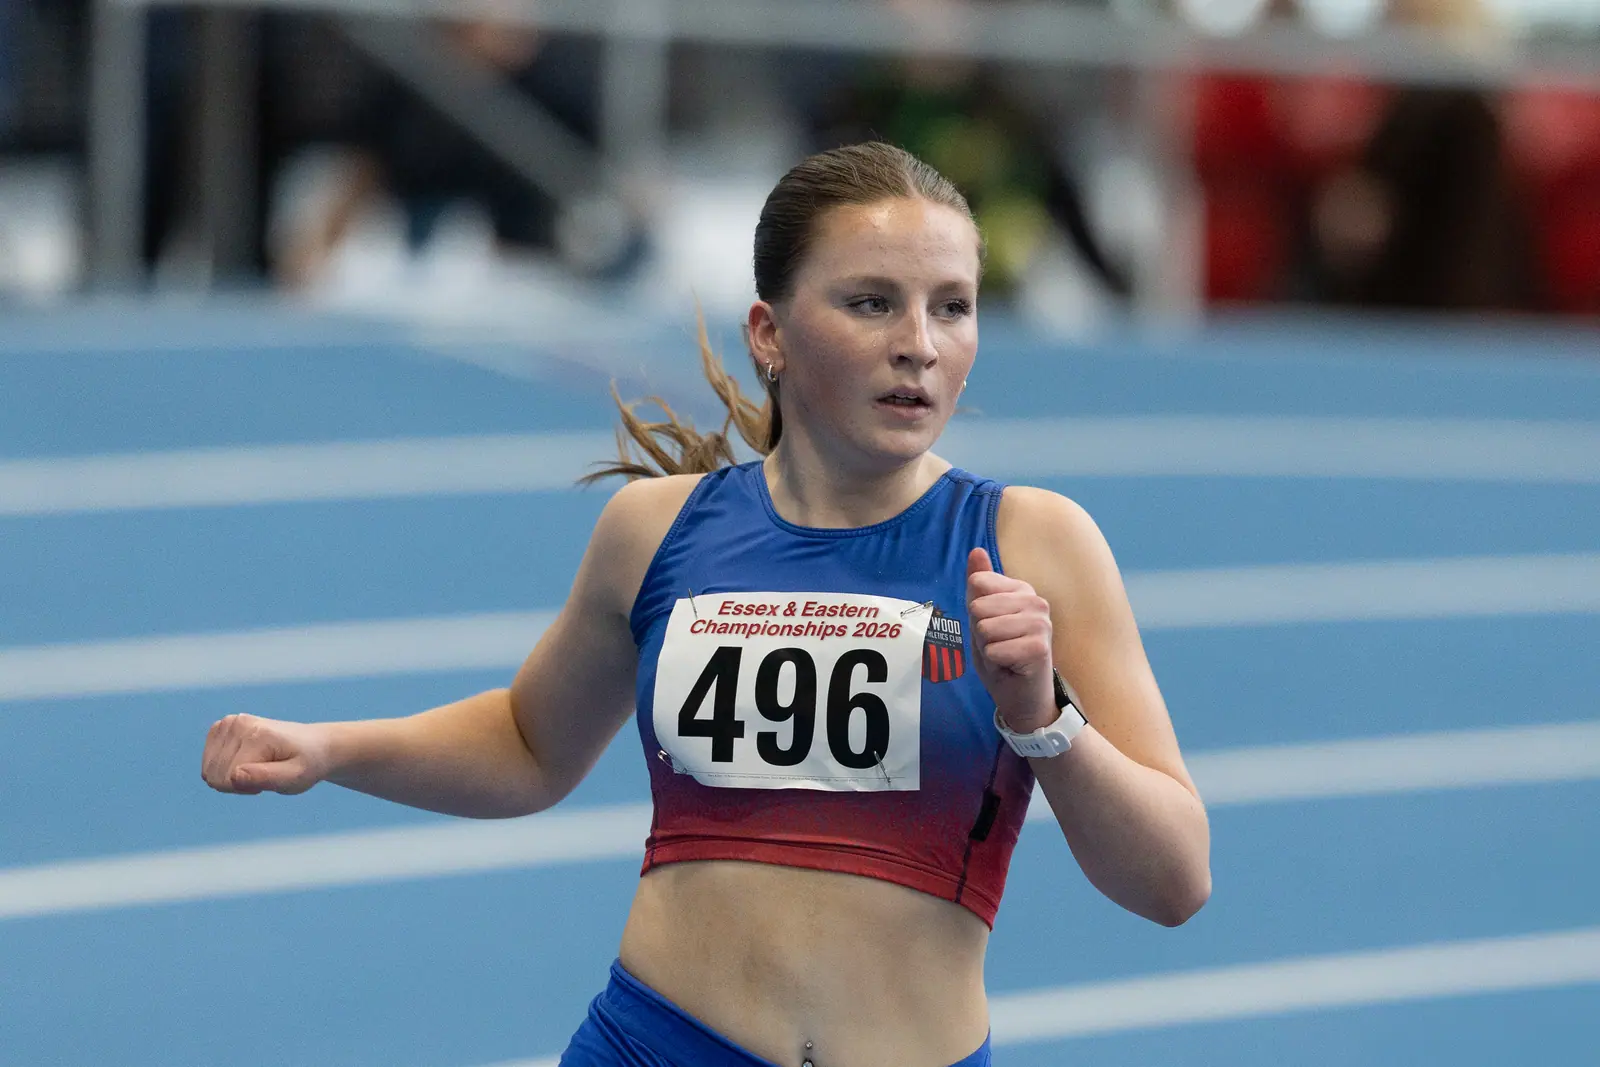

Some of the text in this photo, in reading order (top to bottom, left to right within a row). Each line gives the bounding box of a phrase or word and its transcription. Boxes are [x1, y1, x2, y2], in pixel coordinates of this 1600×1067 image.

[718, 600, 879, 619] Essex & Eastern
[689, 618, 903, 641] Championships 2026
[929, 616, 961, 635] WOOD
[677, 646, 890, 769] 496
